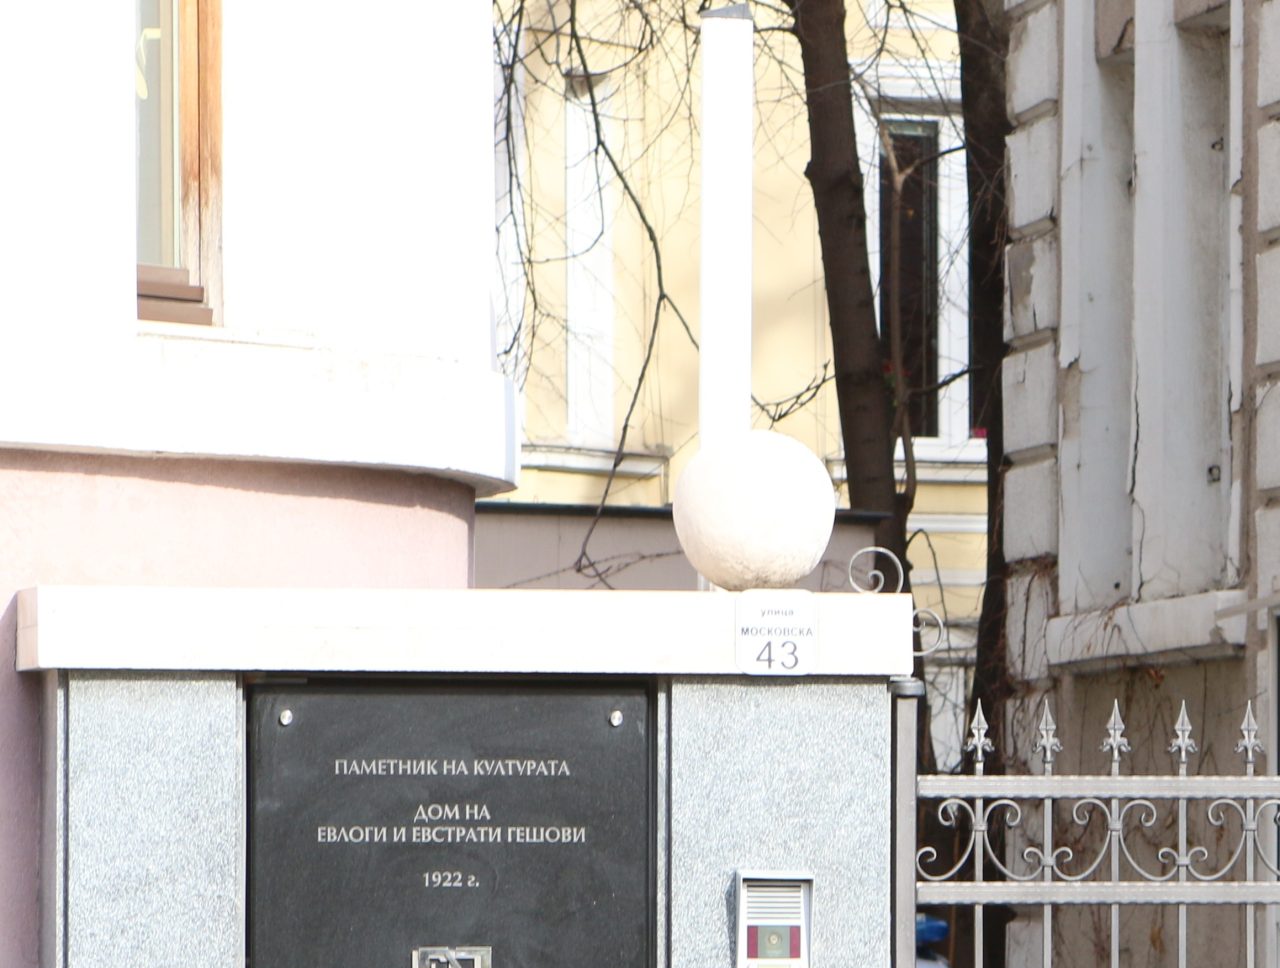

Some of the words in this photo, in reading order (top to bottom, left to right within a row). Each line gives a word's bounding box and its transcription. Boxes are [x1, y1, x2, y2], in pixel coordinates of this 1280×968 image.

[741, 627, 812, 636] МОСКОВСКА
[756, 641, 799, 669] 43
[334, 758, 438, 776] ПАМЕТНИК
[443, 758, 469, 776] НА
[473, 758, 571, 777] КУЛТУРАТА
[413, 803, 461, 824] ДОМ
[465, 803, 492, 821] НА
[317, 825, 388, 844] ЕВЛОГИ
[393, 825, 407, 843] И
[412, 825, 502, 844] ЕВСТРАТИ
[507, 825, 586, 844] ГЕШОВИ
[422, 870, 463, 888] 1922
